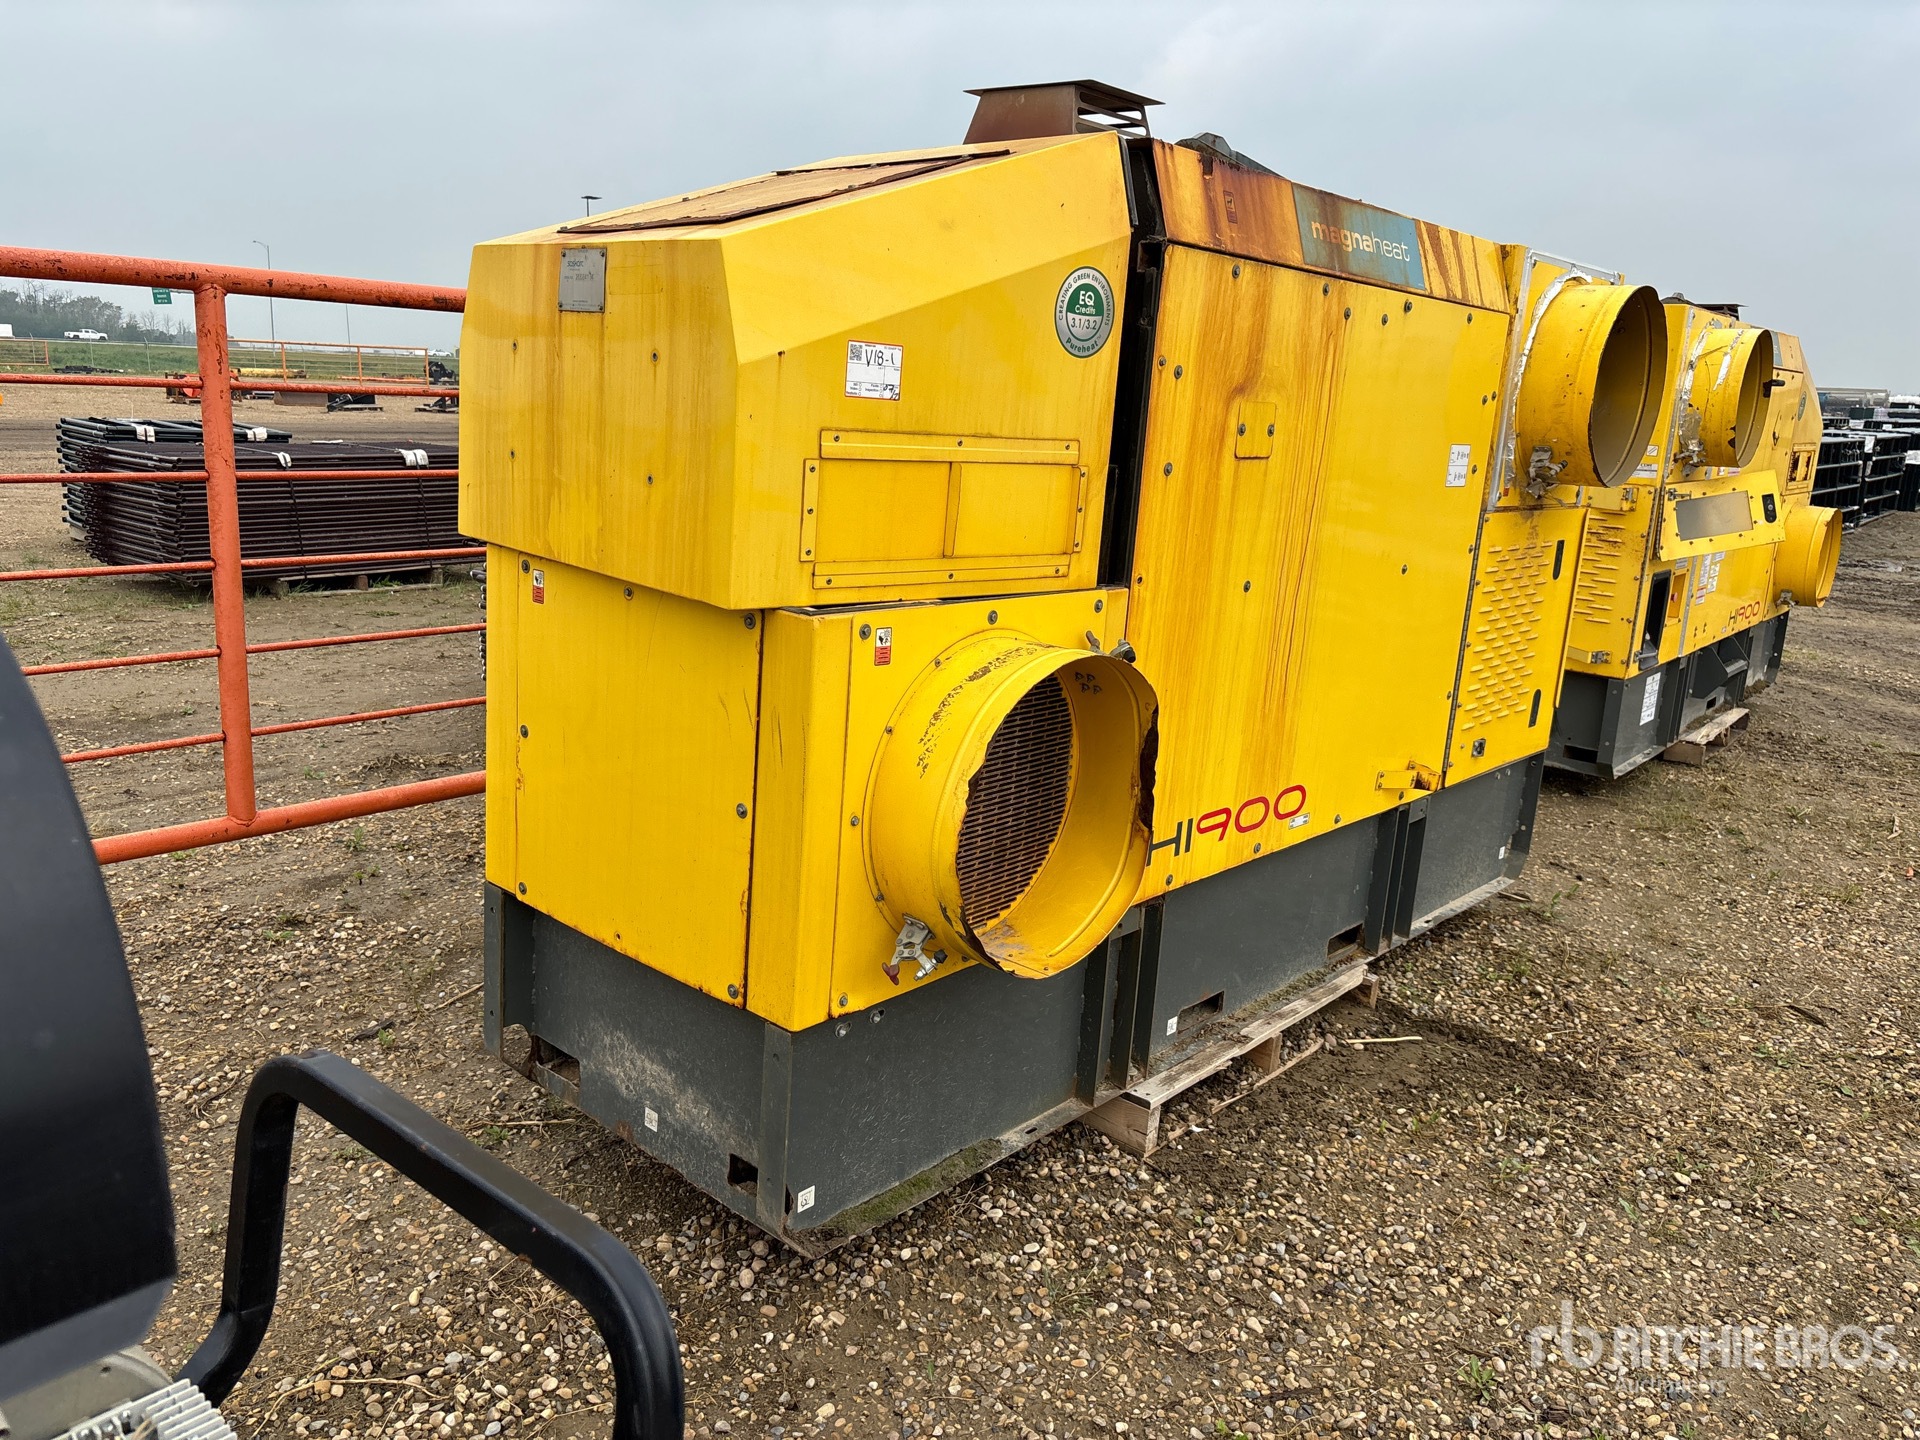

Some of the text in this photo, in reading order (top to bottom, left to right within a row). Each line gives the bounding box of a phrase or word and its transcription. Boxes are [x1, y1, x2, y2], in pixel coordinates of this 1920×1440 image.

[1311, 221, 1410, 262] magnaheat
[1059, 272, 1112, 326] CREATING GREEN ENVIRONMENTS
[1079, 290, 1095, 306] EQ
[1075, 304, 1096, 315] Credits
[1071, 316, 1098, 331] 3.1/3.2
